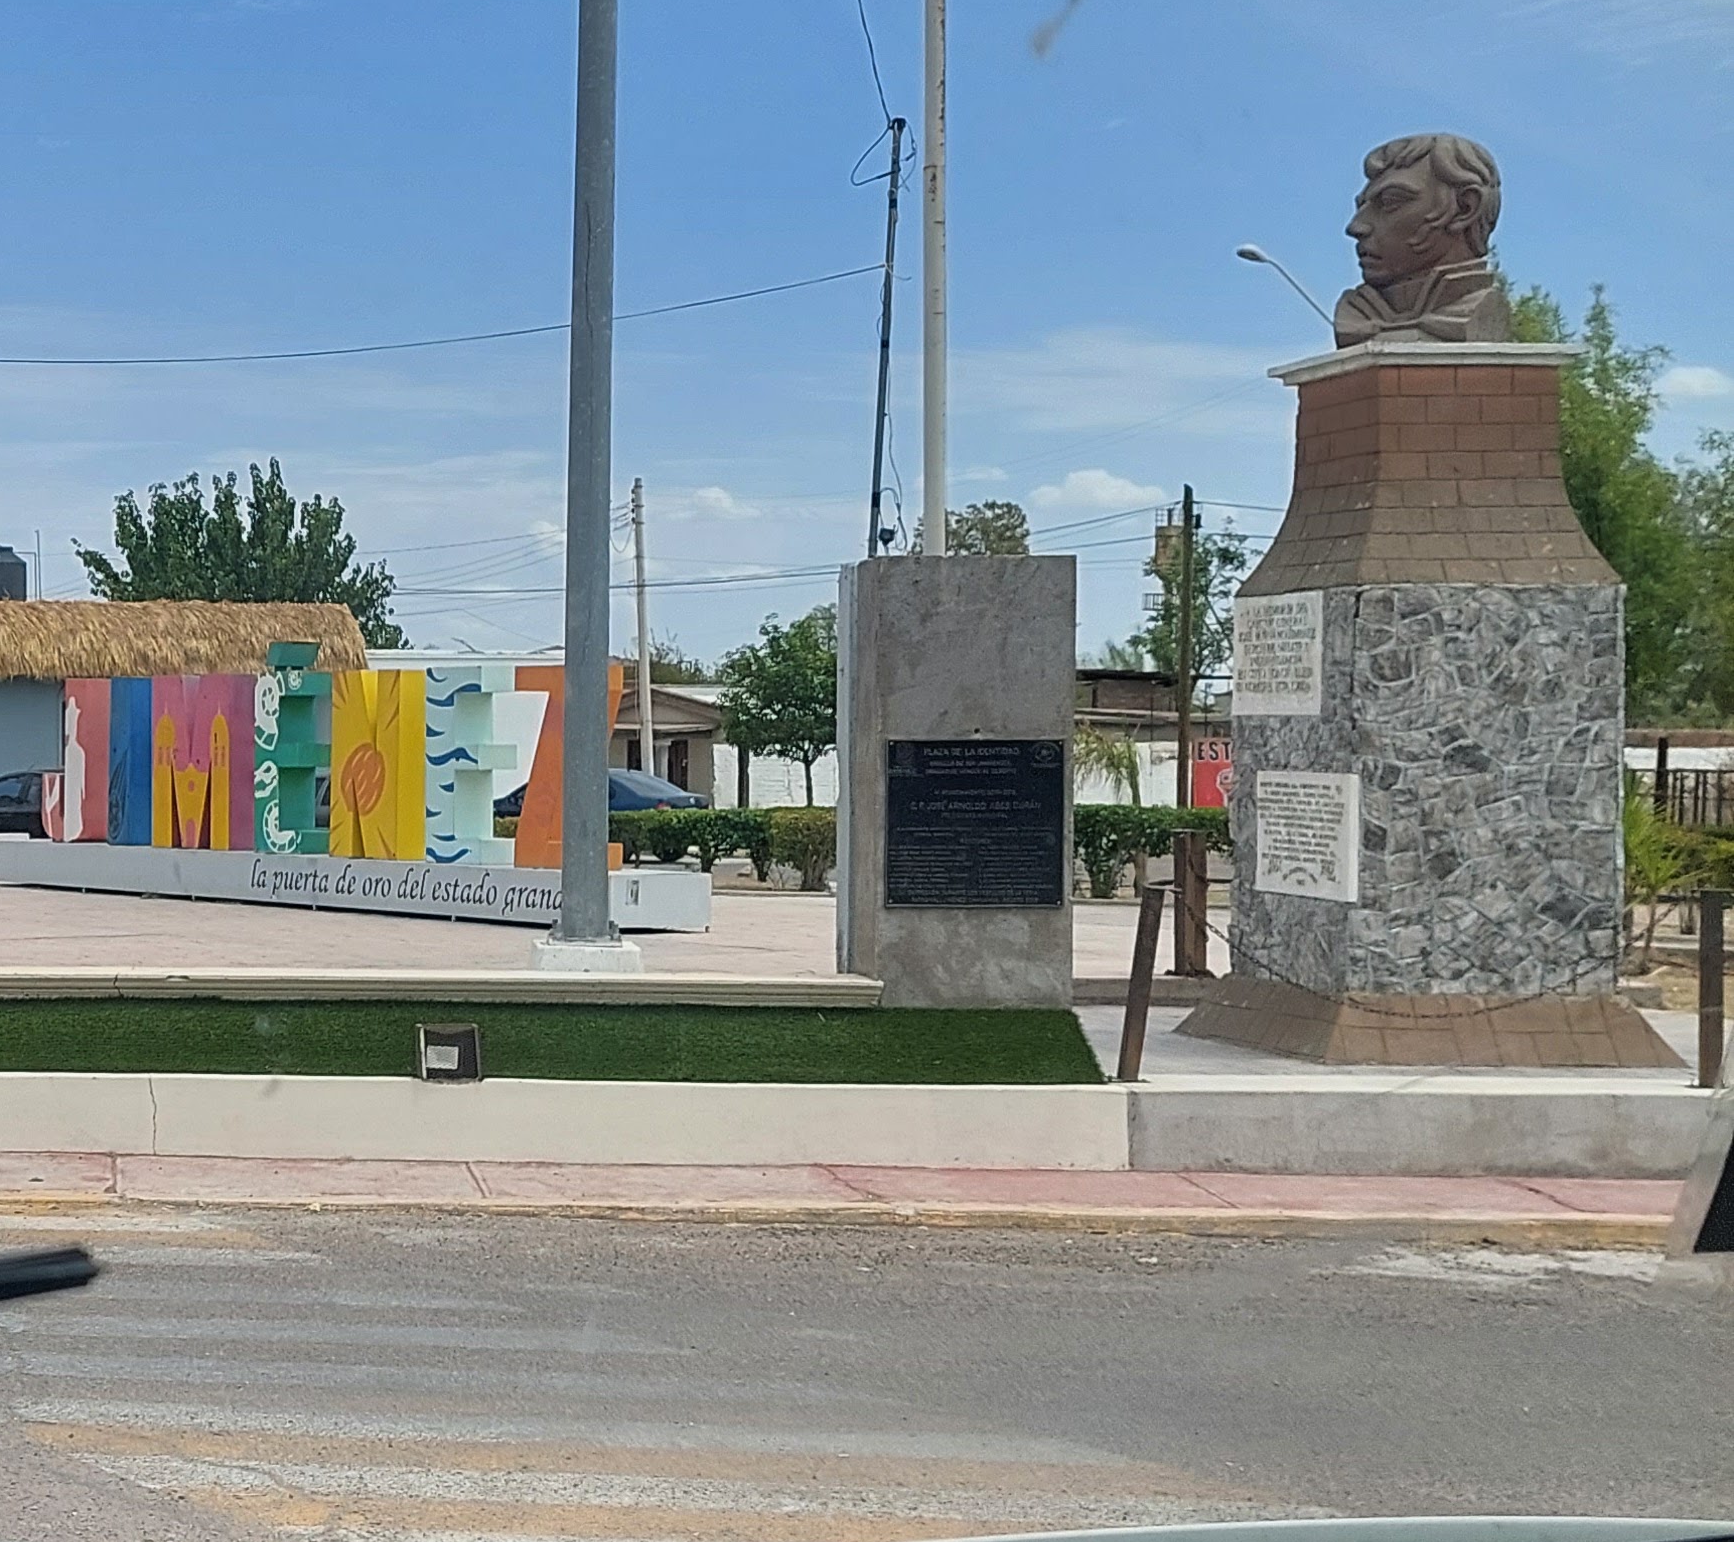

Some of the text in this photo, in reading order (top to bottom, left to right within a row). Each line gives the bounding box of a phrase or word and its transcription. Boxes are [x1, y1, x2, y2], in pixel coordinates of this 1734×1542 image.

[250, 858, 267, 889] la
[271, 867, 329, 896] puerta
[334, 864, 356, 896] de
[361, 875, 392, 898] oro
[397, 867, 428, 900] del
[431, 869, 498, 906] estado
